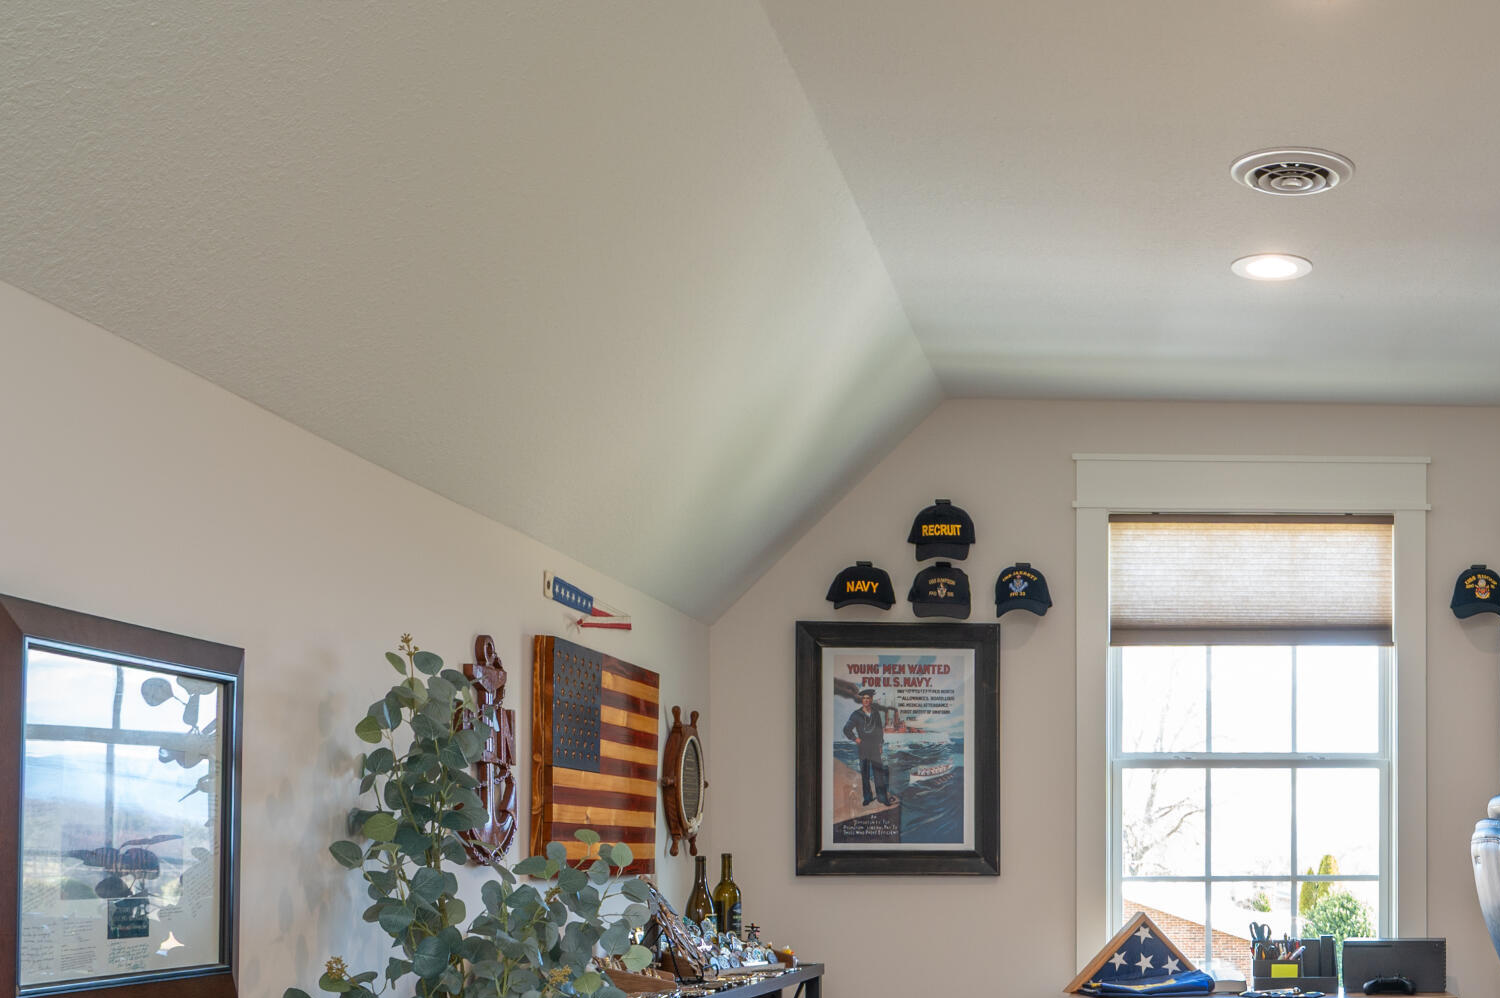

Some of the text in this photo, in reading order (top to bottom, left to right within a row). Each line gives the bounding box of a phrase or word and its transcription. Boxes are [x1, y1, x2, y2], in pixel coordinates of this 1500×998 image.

[922, 524, 961, 536] RECRUIT
[846, 580, 879, 593] NAVY
[847, 664, 951, 675] YOUNG MEN WANTED
[862, 677, 881, 687] FOR
